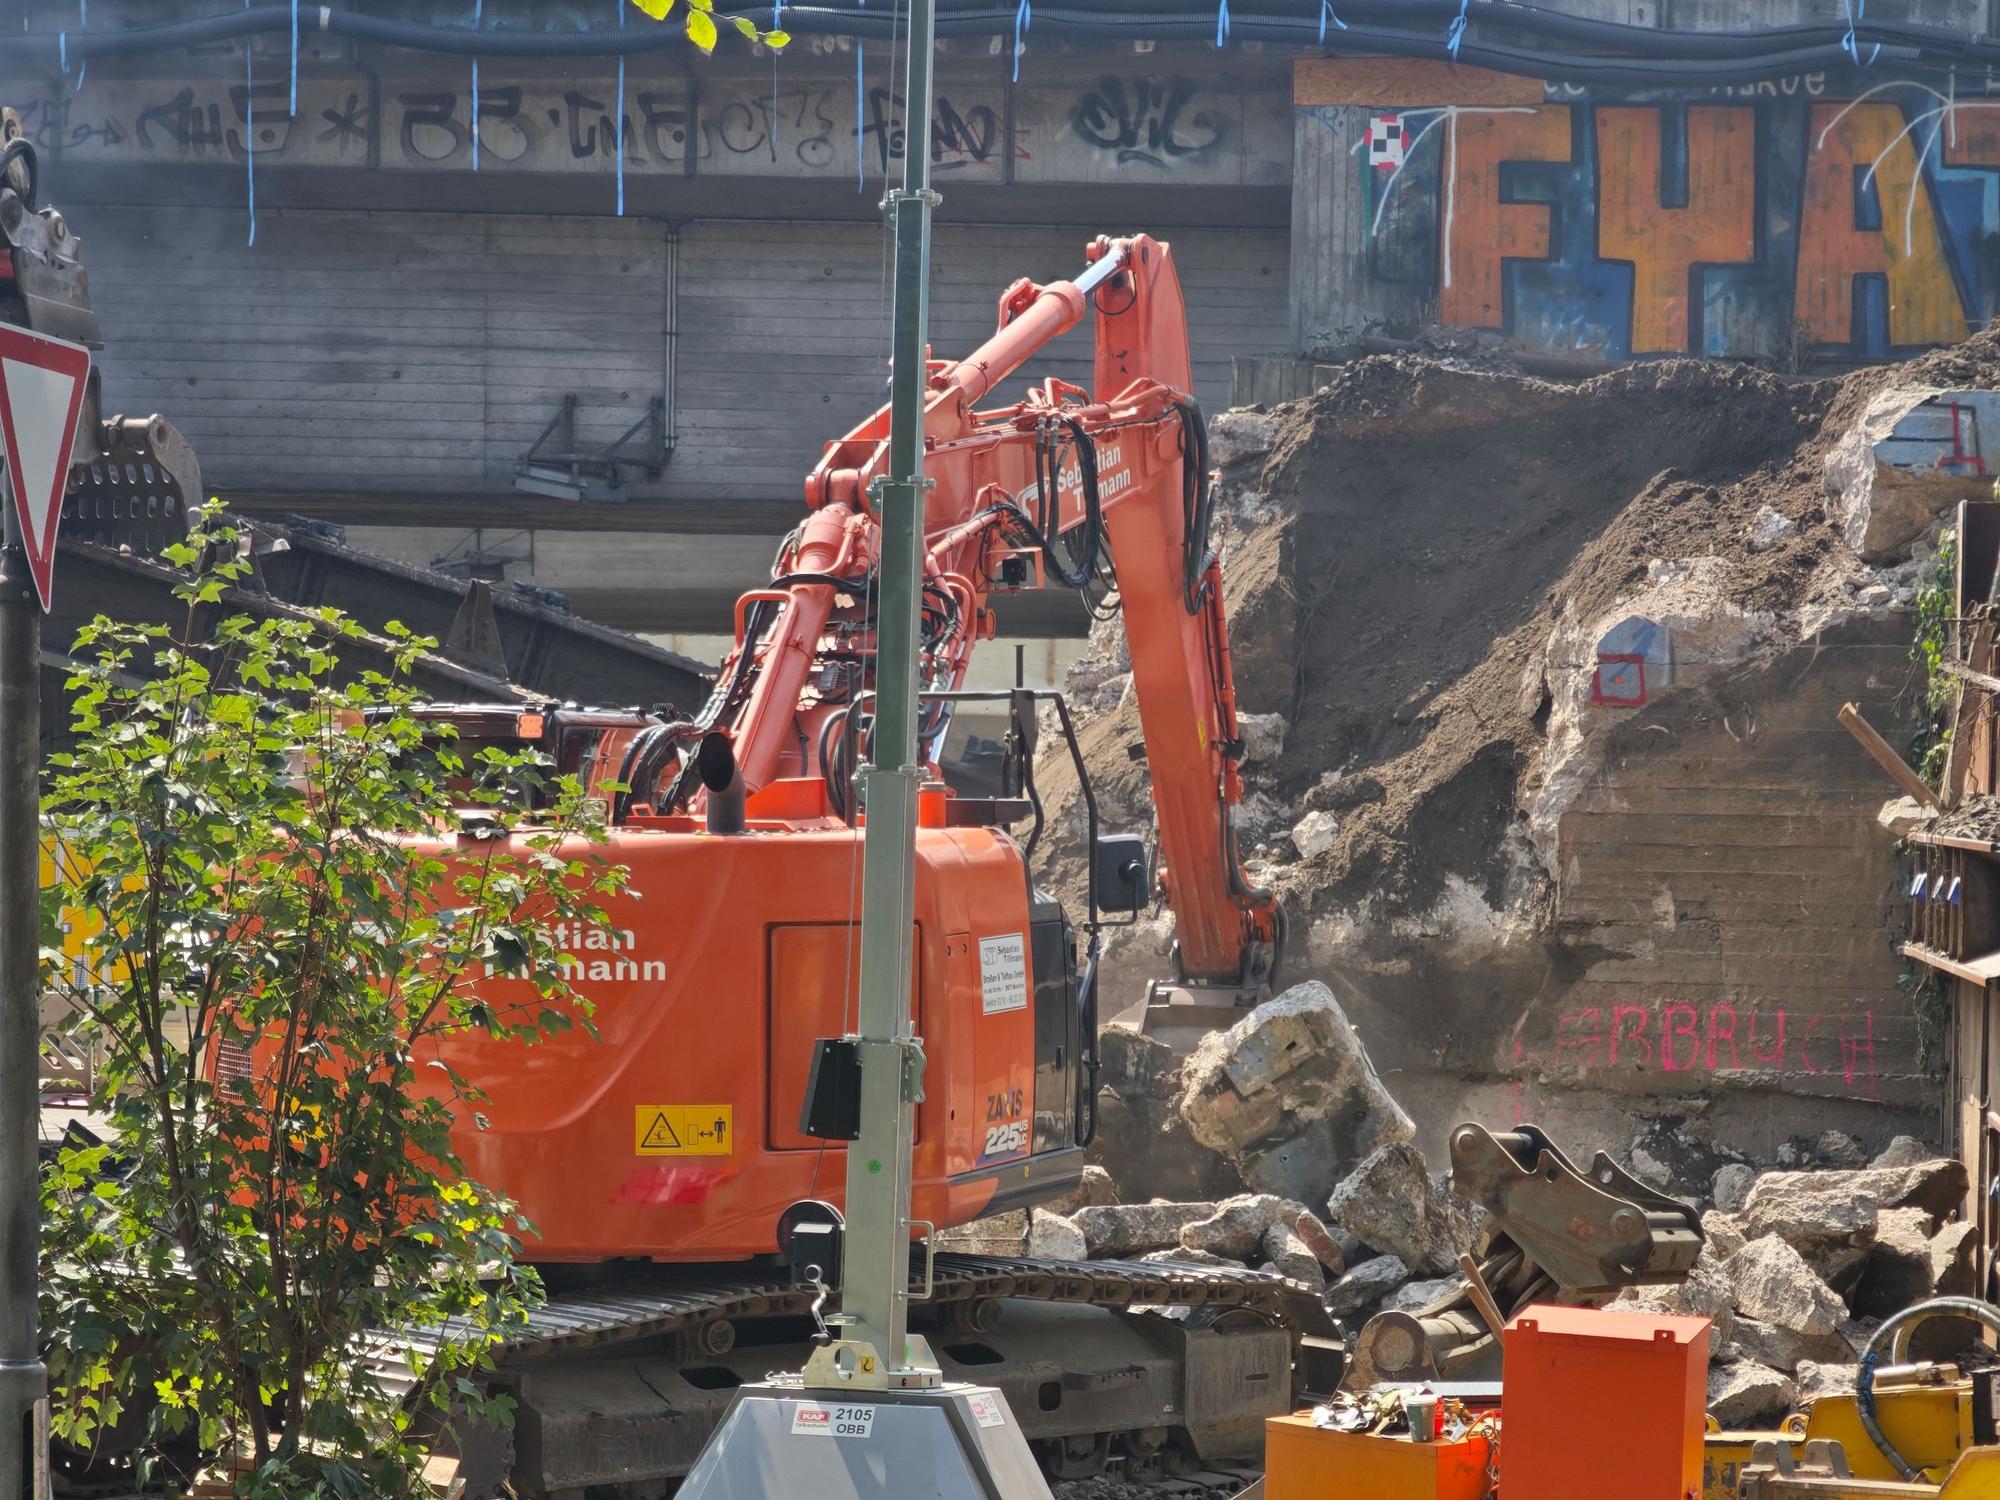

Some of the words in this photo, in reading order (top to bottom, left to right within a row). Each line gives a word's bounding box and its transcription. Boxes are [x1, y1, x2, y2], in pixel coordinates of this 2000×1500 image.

[1057, 446, 1121, 494] Sebtian
[1073, 468, 1131, 512] Tmann
[985, 1122, 1020, 1156] 225
[835, 1408, 873, 1421] 2105
[836, 1423, 866, 1435] OBB
